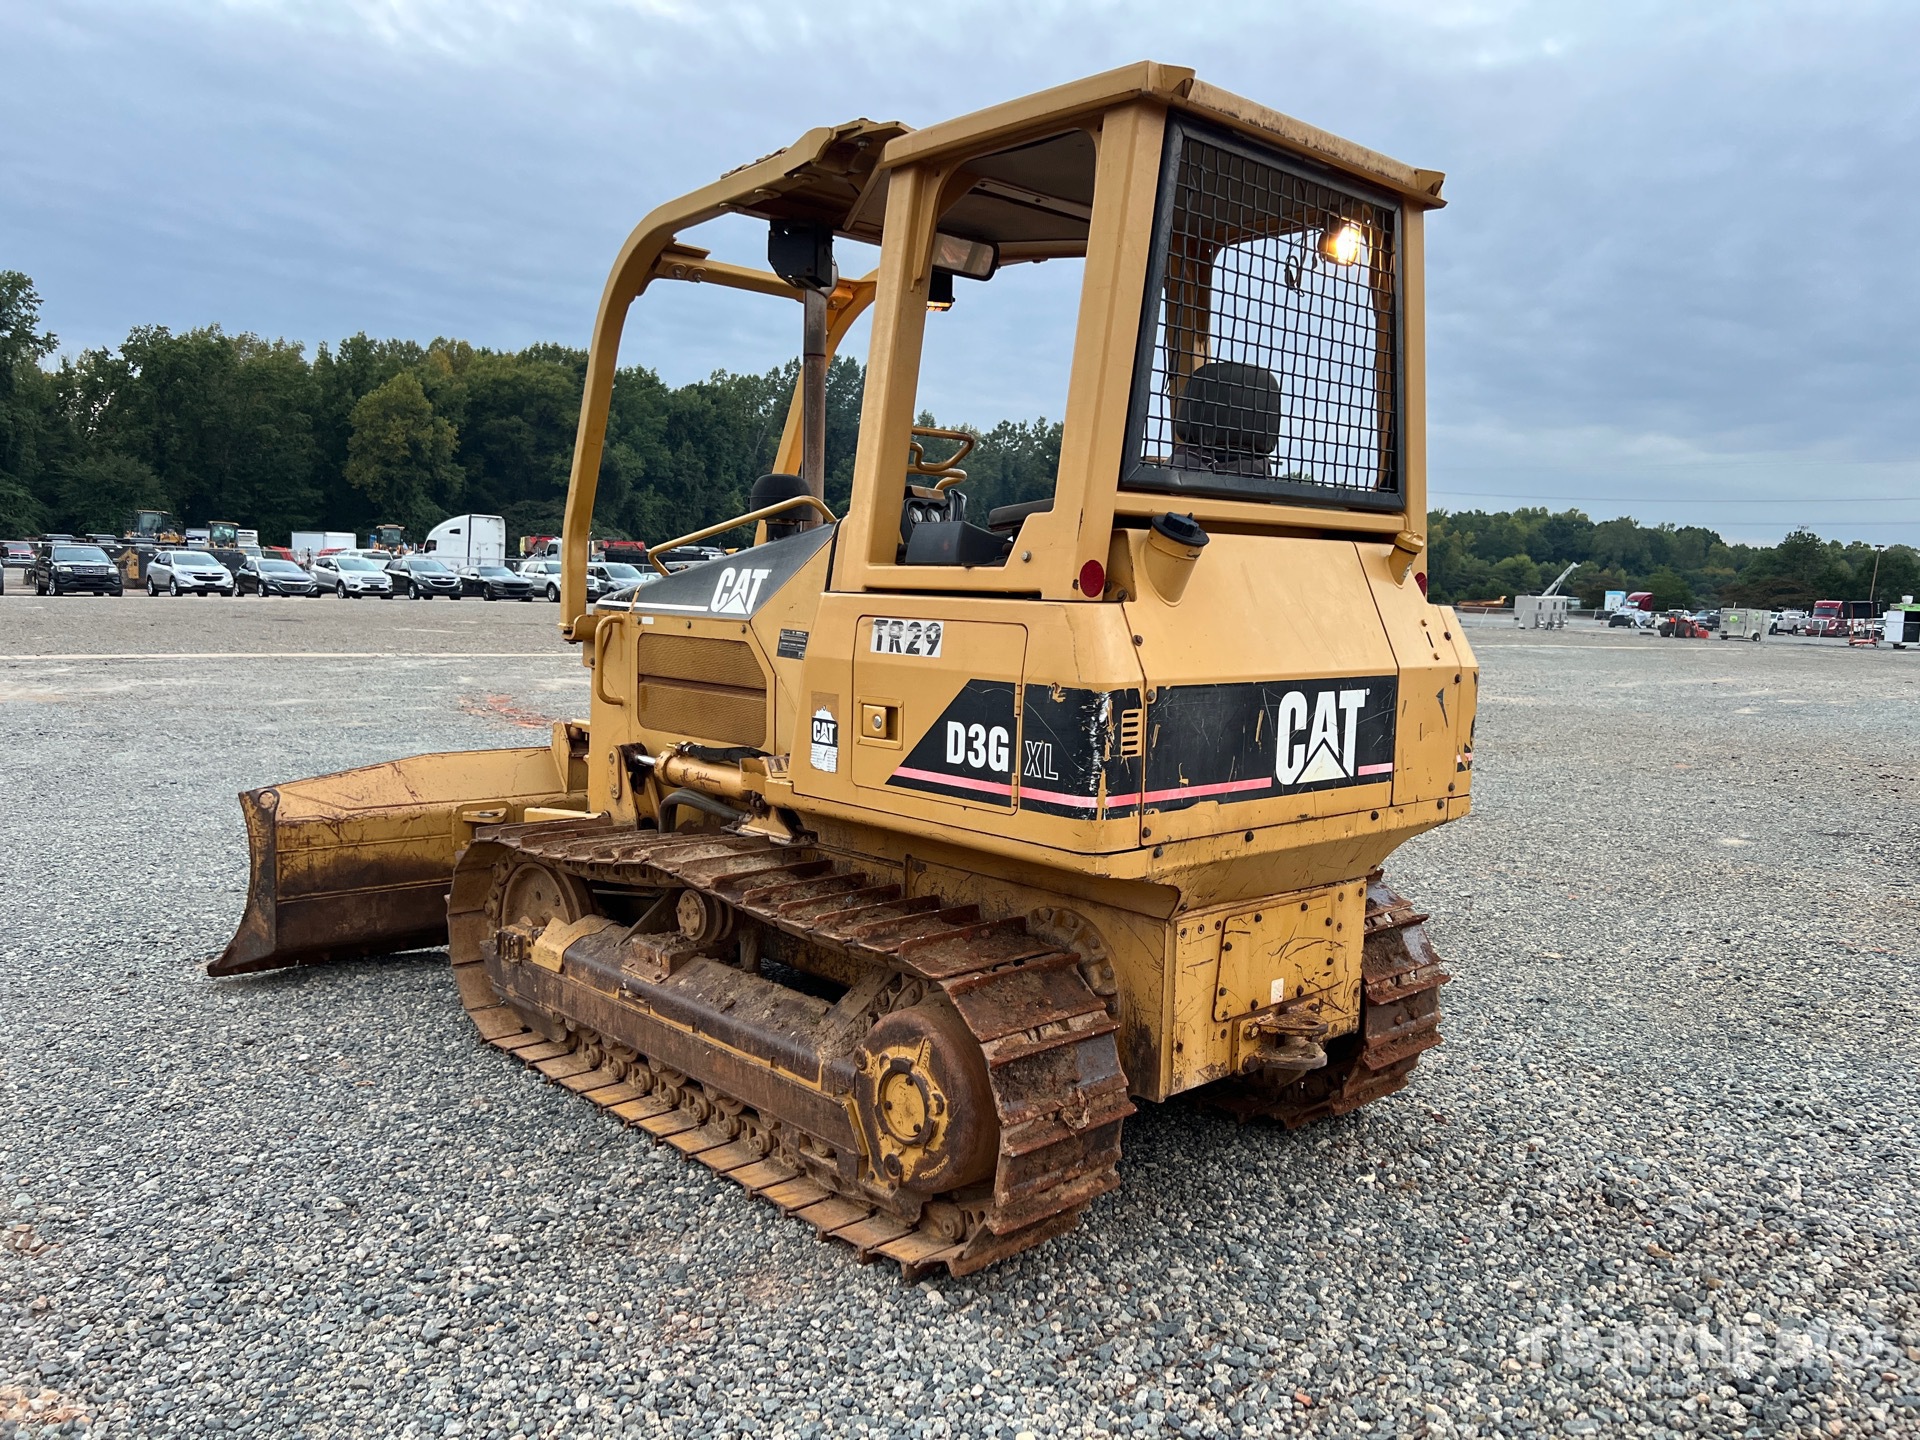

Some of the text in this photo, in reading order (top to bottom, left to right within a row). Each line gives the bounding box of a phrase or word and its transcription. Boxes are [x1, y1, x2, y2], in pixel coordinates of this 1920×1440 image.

[710, 566, 769, 616] CAT
[873, 618, 943, 656] TR29
[812, 720, 835, 745] CAT
[946, 720, 1059, 781] D3G XL
[1275, 689, 1366, 786] CAT
